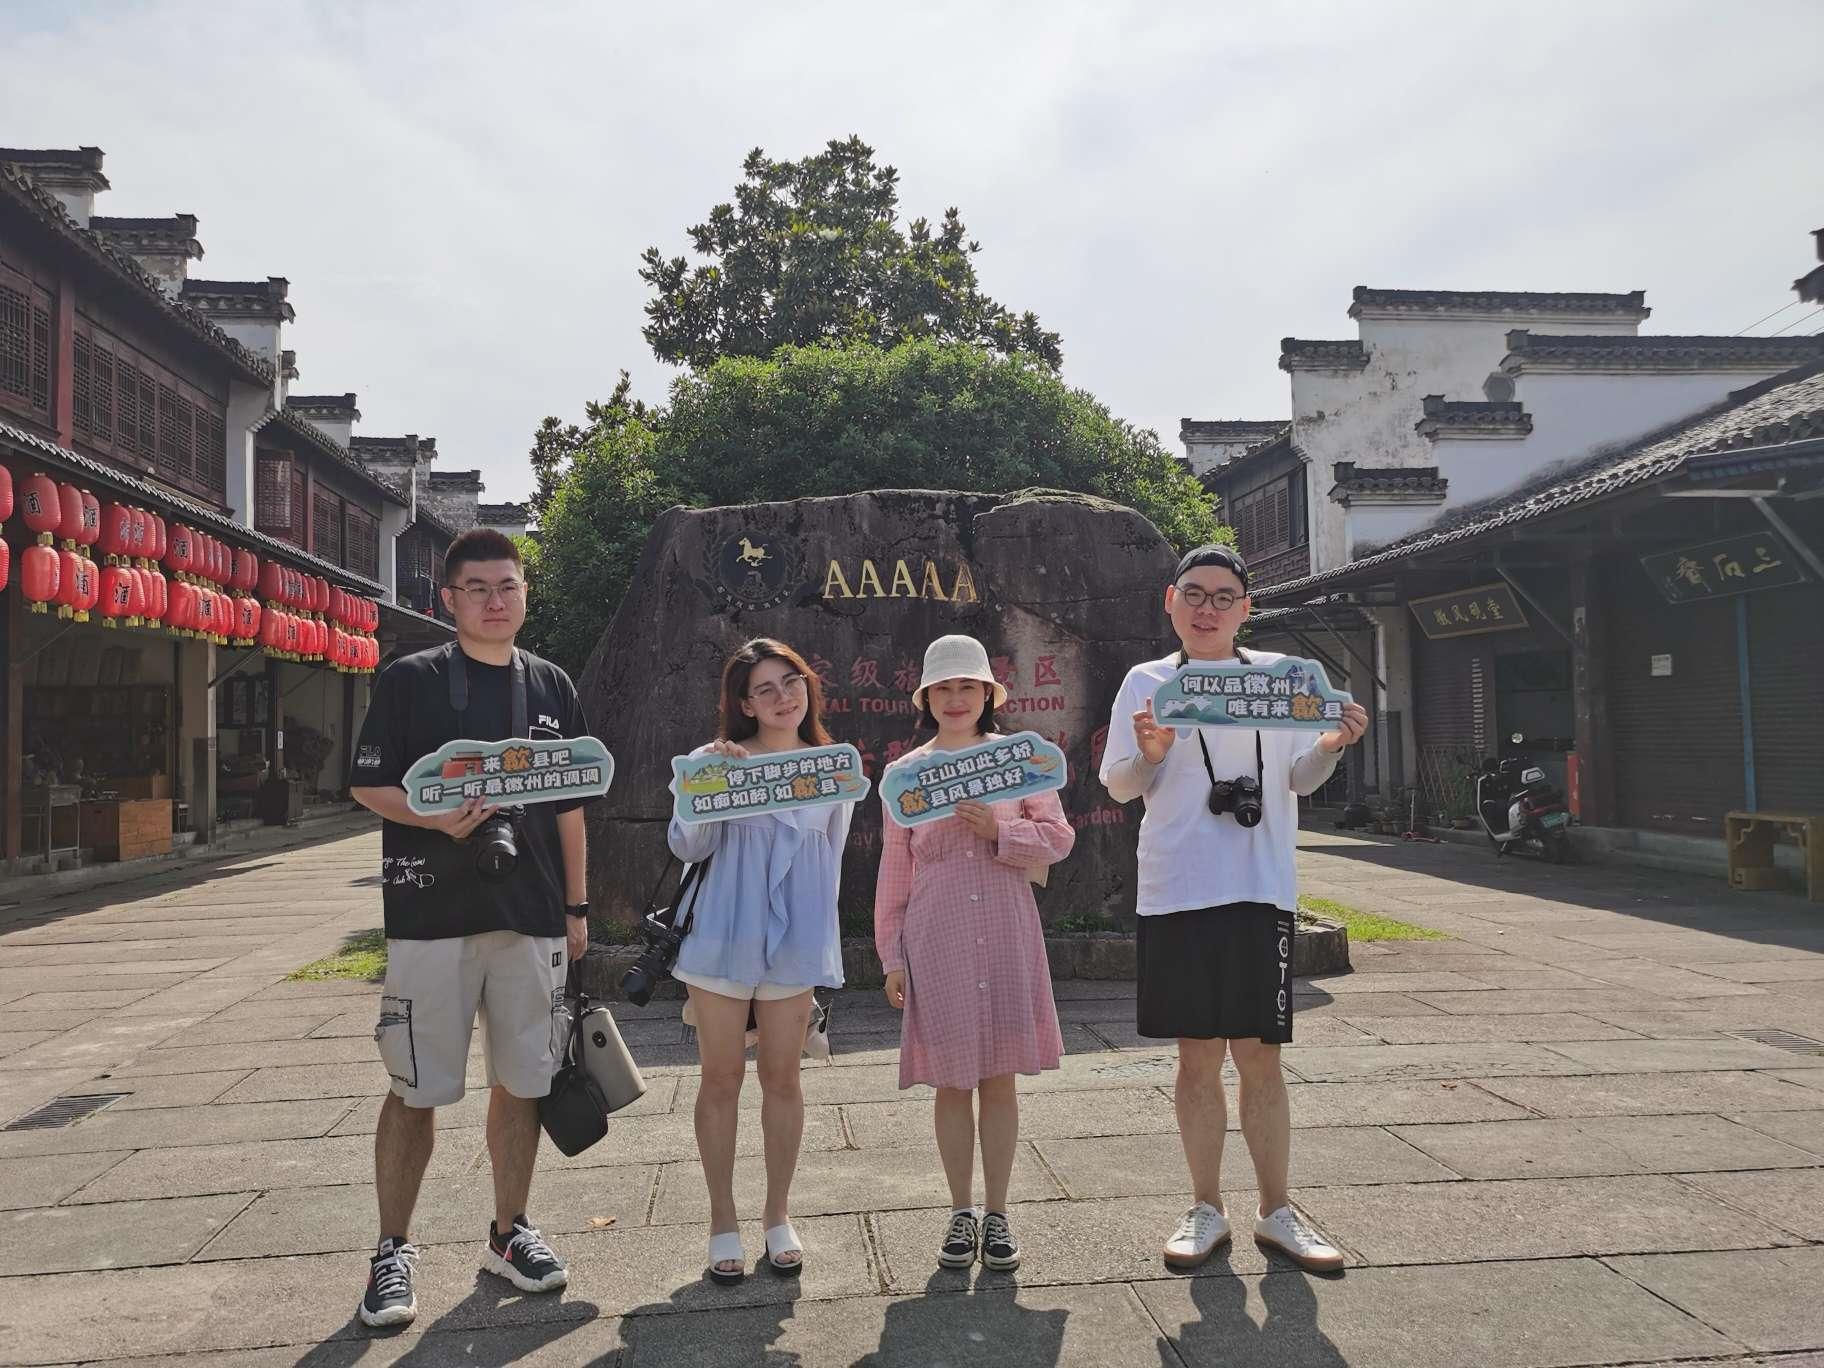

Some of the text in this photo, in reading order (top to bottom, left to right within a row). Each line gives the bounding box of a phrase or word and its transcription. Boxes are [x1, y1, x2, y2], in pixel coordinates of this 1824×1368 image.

[114, 582, 130, 607] 酒
[821, 559, 981, 603] AAAAA
[1181, 673, 1291, 695] 何以品徽州
[539, 714, 560, 730] FILA
[1228, 692, 1343, 721] 唯有来歙县
[483, 747, 571, 772] 来歙县吧
[727, 753, 850, 786] 停下脚步的地方
[919, 740, 1034, 786] 江山如此多娇
[422, 768, 600, 803] 听一听最徽州的调调
[693, 775, 838, 813] 如痴如醉 如歙县
[897, 767, 1023, 816] 歙县风景独好
